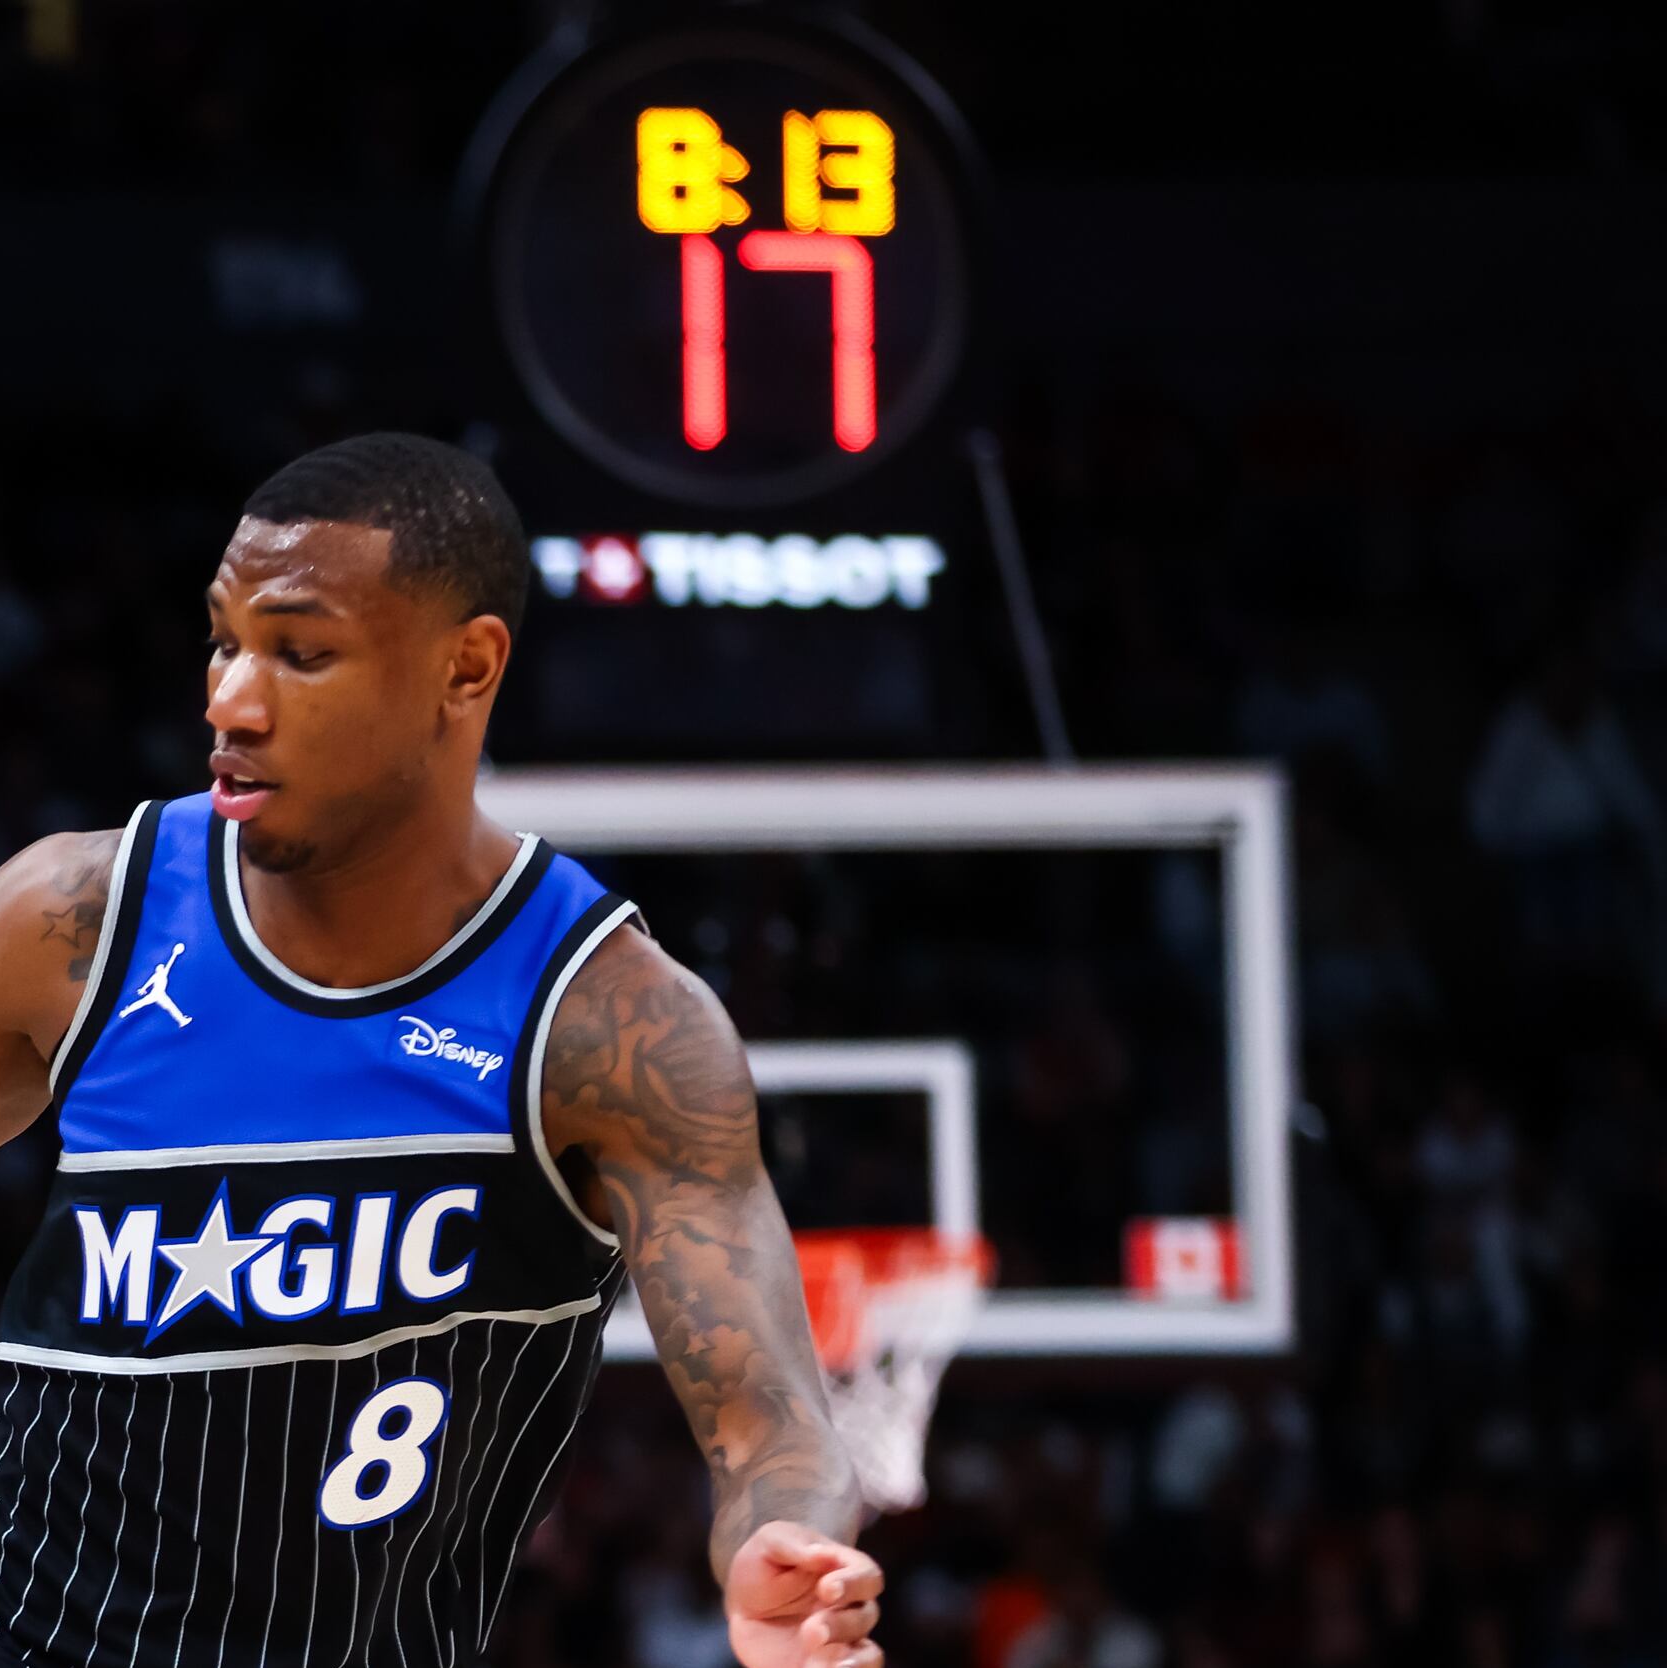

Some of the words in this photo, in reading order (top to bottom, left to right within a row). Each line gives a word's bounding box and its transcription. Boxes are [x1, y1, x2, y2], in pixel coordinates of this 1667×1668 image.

[637, 106, 896, 236] 8:13
[680, 229, 877, 452] 17
[397, 1014, 505, 1082] Disney
[72, 1176, 483, 1348] MAGIC
[317, 1375, 451, 1531] 8
